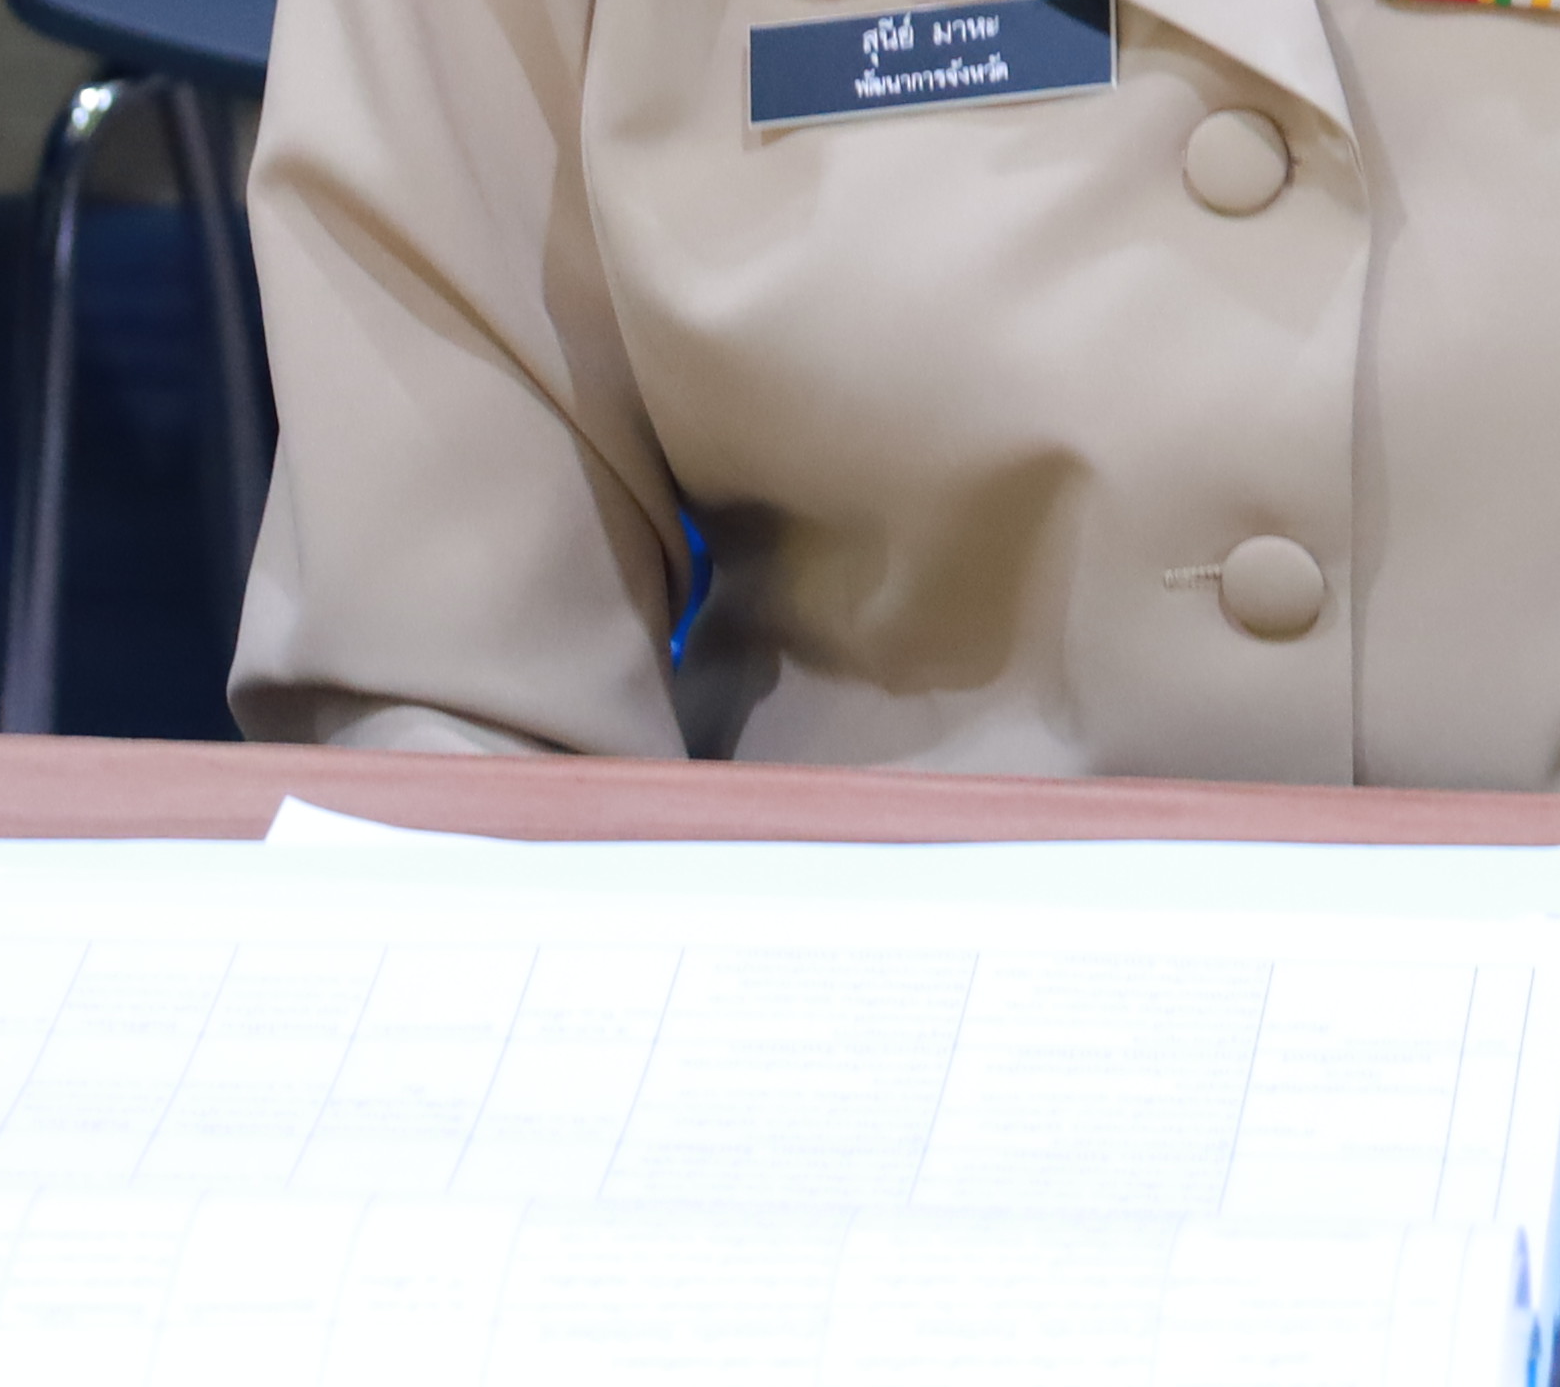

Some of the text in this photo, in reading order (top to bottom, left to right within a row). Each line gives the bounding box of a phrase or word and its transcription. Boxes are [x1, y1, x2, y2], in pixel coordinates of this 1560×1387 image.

[862, 11, 915, 68] สุนีย์
[854, 51, 1009, 99] พัฒนาการจังหวัด
